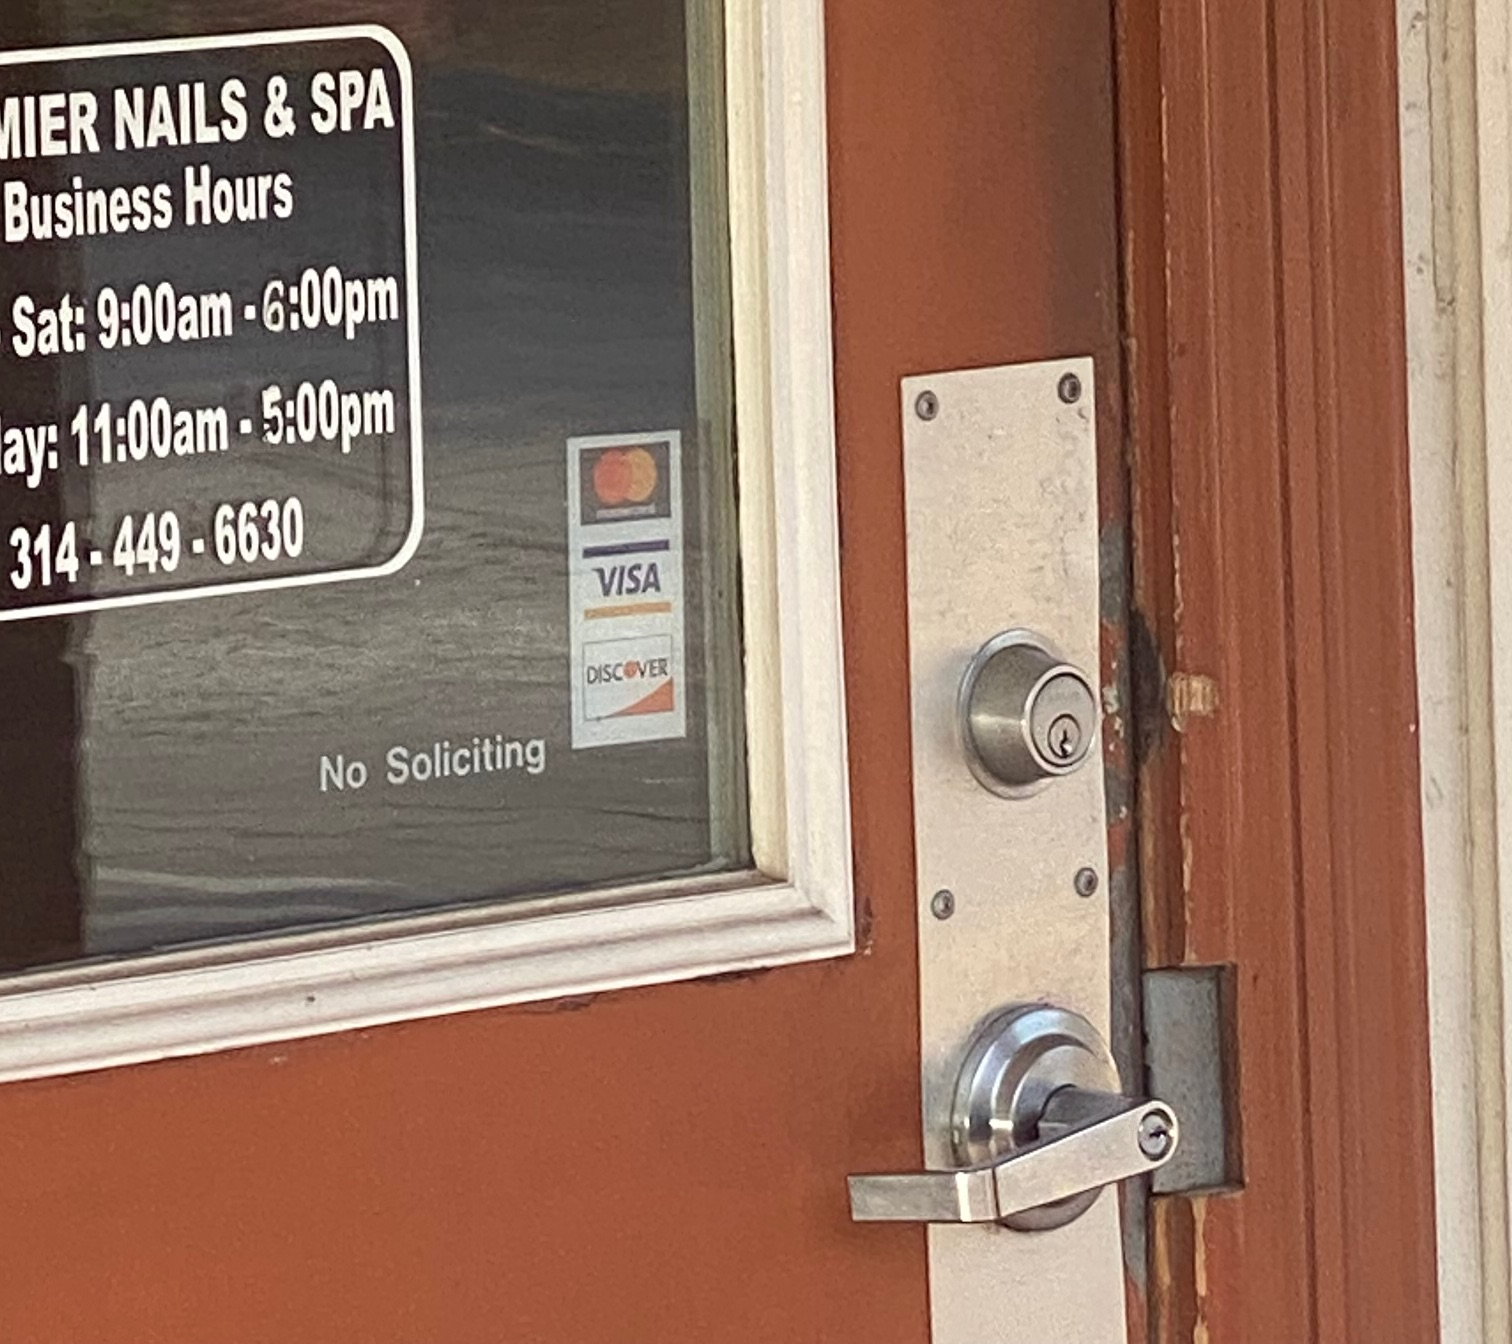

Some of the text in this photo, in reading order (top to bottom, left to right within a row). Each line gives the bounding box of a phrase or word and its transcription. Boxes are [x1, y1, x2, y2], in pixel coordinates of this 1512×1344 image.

[113, 79, 248, 152] NAILS
[263, 75, 296, 138] &
[310, 68, 395, 135] SPA
[4, 164, 294, 242] Business Hours
[12, 294, 86, 358] Sat:
[97, 282, 234, 350] 9:00am
[262, 266, 399, 340] 6:00pm
[71, 396, 229, 466] 11:00am
[262, 379, 396, 454] 5:00pm
[592, 562, 661, 597] VISA
[586, 658, 668, 685] DISCOVER
[320, 734, 546, 793] No Soliciting
